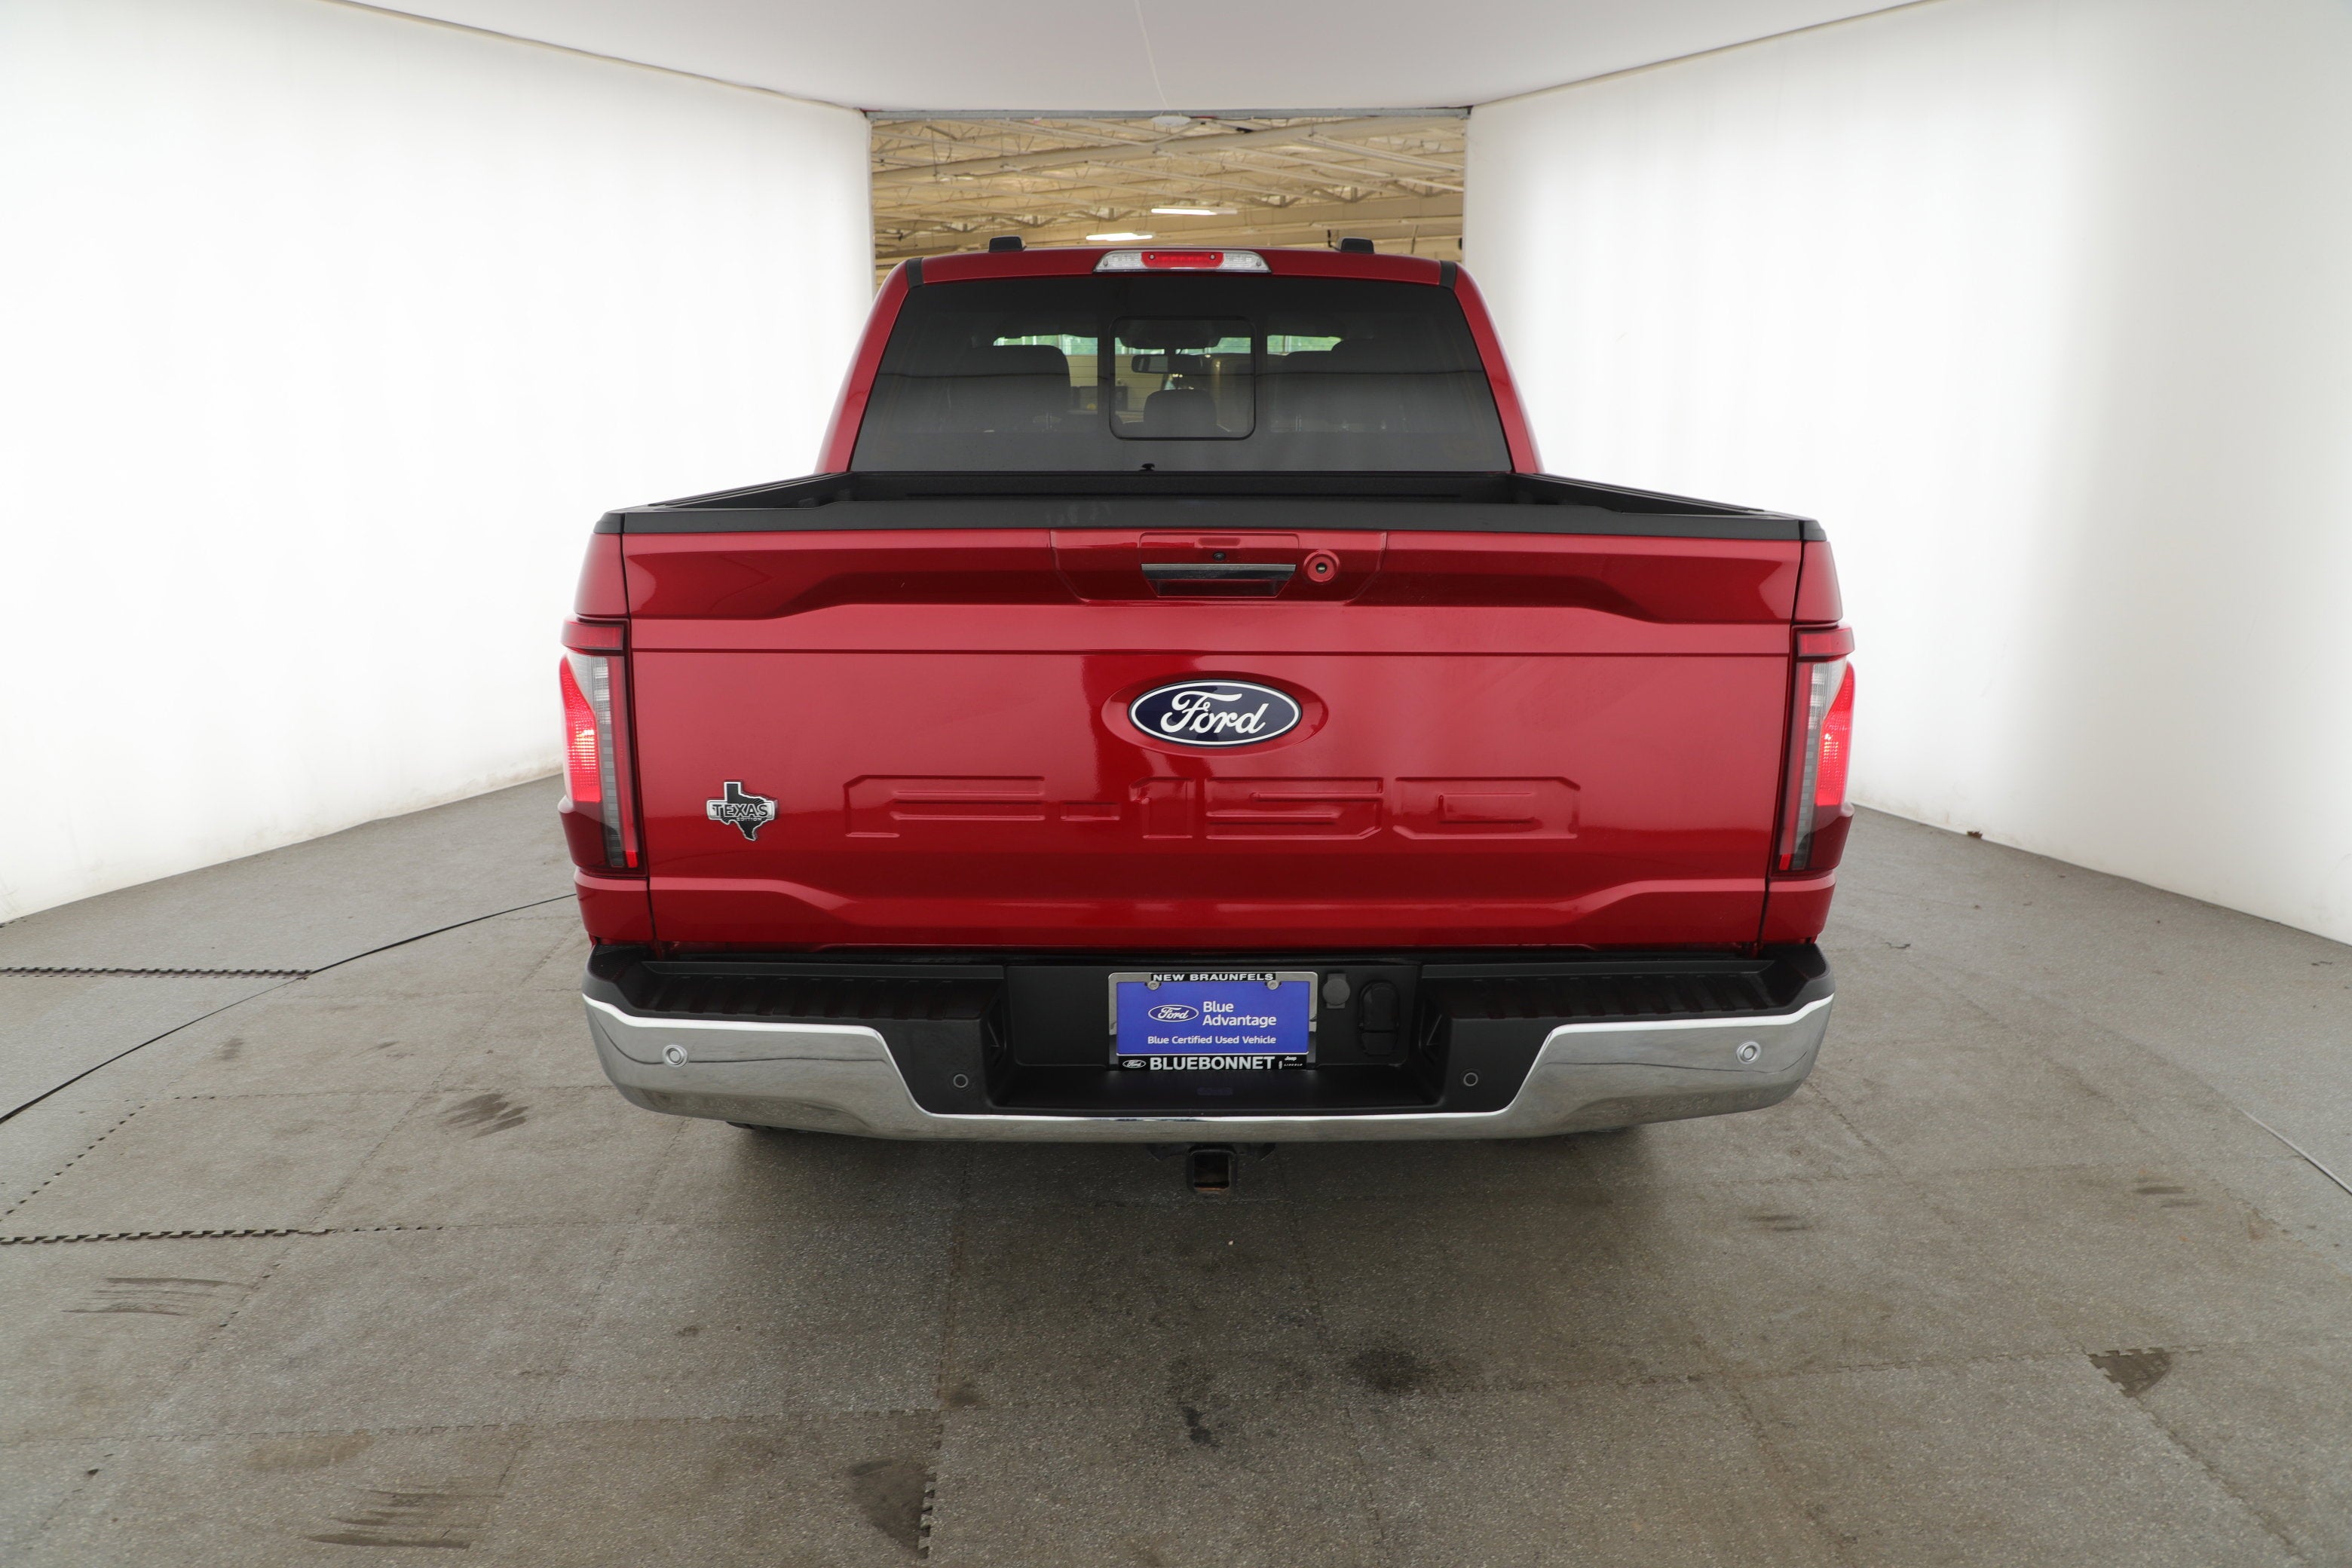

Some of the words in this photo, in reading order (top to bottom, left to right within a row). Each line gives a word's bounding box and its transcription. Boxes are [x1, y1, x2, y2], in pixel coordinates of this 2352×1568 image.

[1160, 691, 1269, 733] Ford
[712, 804, 768, 817] TEXAS
[843, 775, 1581, 839] F-150
[1158, 1007, 1190, 1019] Ford
[1203, 1001, 1234, 1012] Blue
[1202, 1015, 1277, 1028] Advantage
[1147, 1036, 1169, 1044] Blue
[1171, 1036, 1212, 1044] Certified
[1215, 1036, 1239, 1044] Used
[1242, 1036, 1276, 1044] Vehicle
[1150, 1056, 1276, 1070] BLUEBONNET
